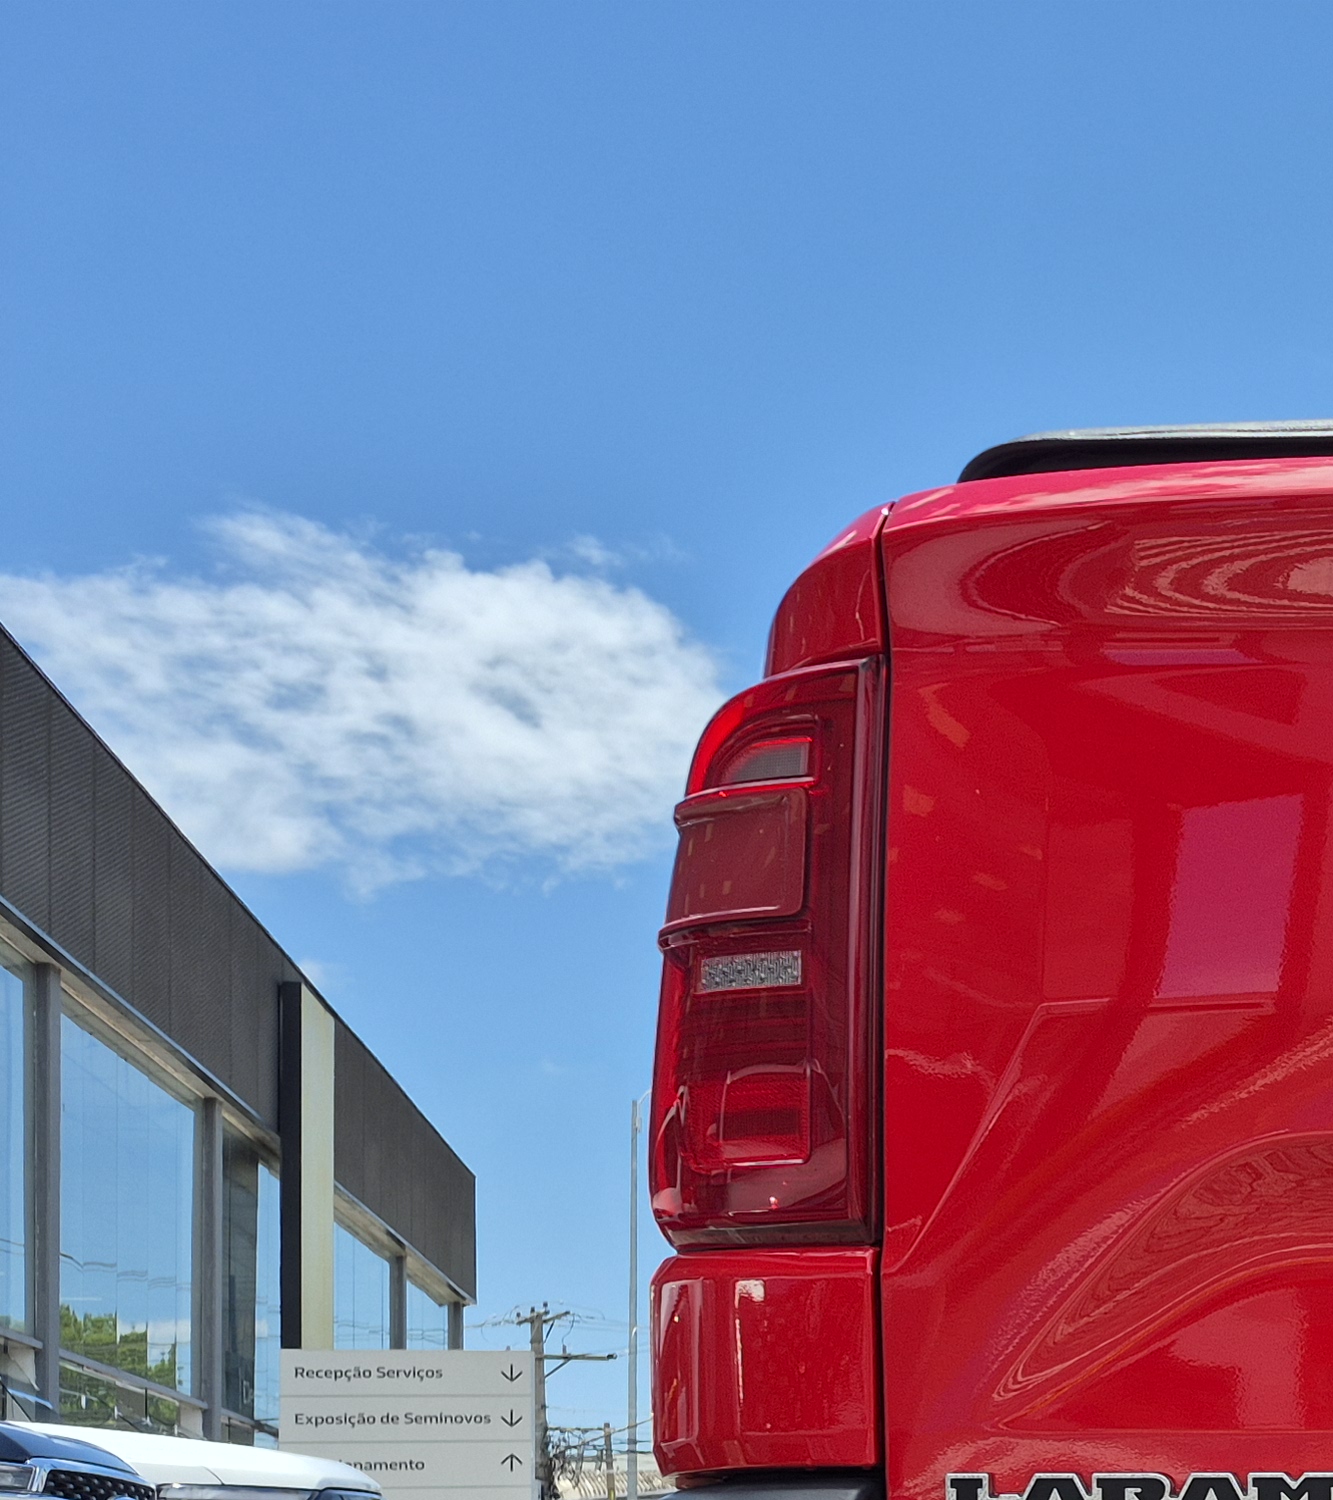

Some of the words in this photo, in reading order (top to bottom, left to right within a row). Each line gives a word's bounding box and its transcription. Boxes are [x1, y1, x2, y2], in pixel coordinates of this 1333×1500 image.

[294, 1366, 372, 1382] Recepção
[376, 1366, 443, 1381] Serviços
[294, 1412, 376, 1428] Exposição
[380, 1412, 400, 1425] de
[404, 1411, 492, 1425] Seminovos
